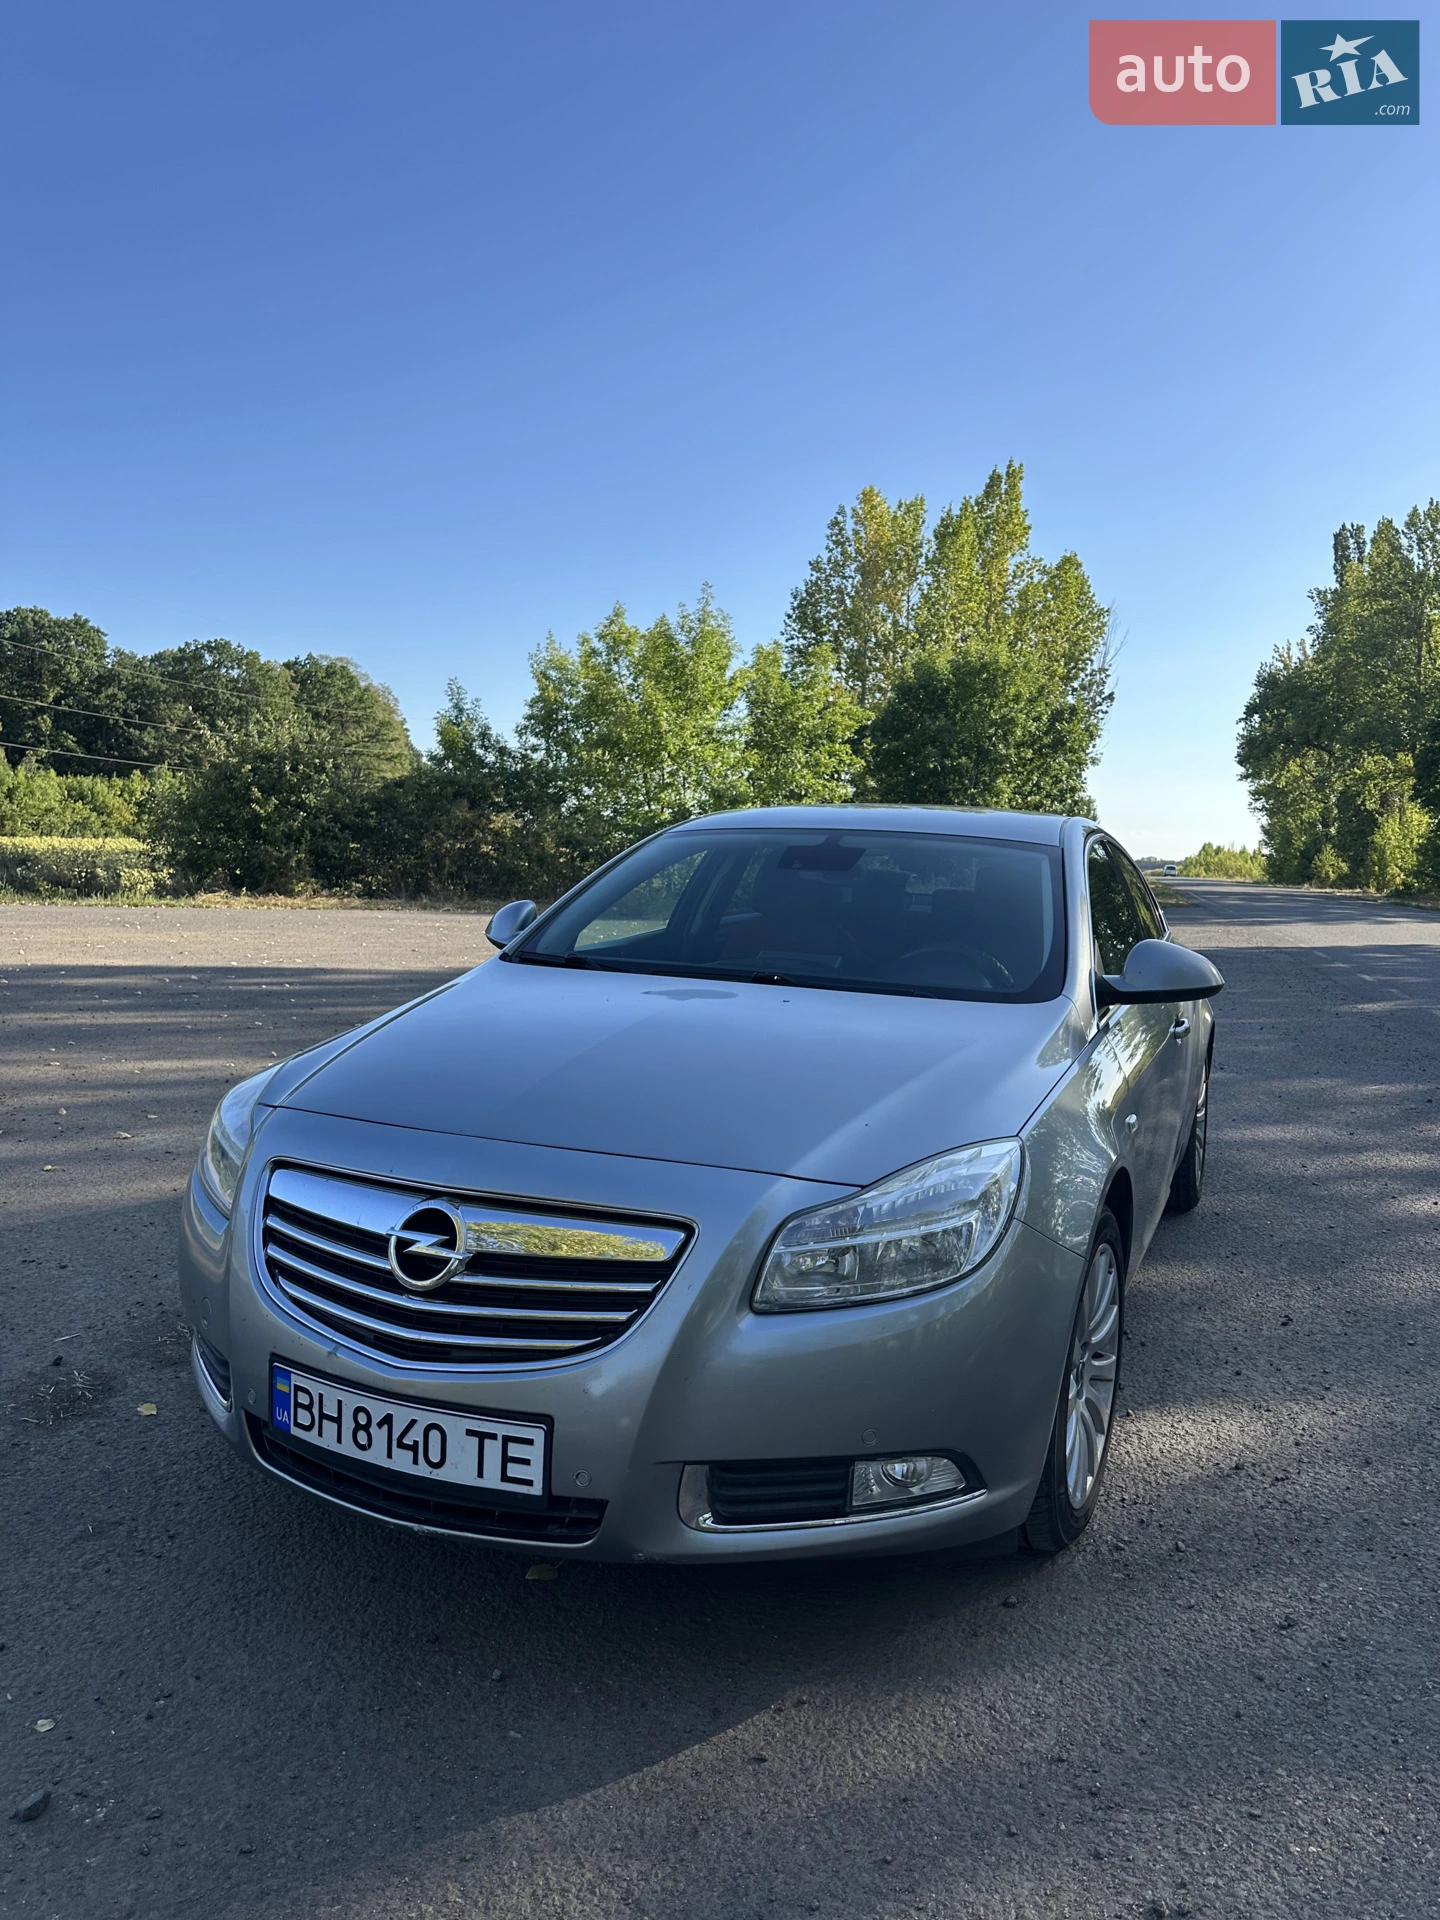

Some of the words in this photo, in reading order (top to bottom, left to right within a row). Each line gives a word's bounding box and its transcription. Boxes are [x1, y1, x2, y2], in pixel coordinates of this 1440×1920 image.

[276, 1406, 290, 1424] UA
[293, 1383, 343, 1445] BH
[352, 1405, 447, 1469] 8140
[465, 1428, 535, 1487] TE
